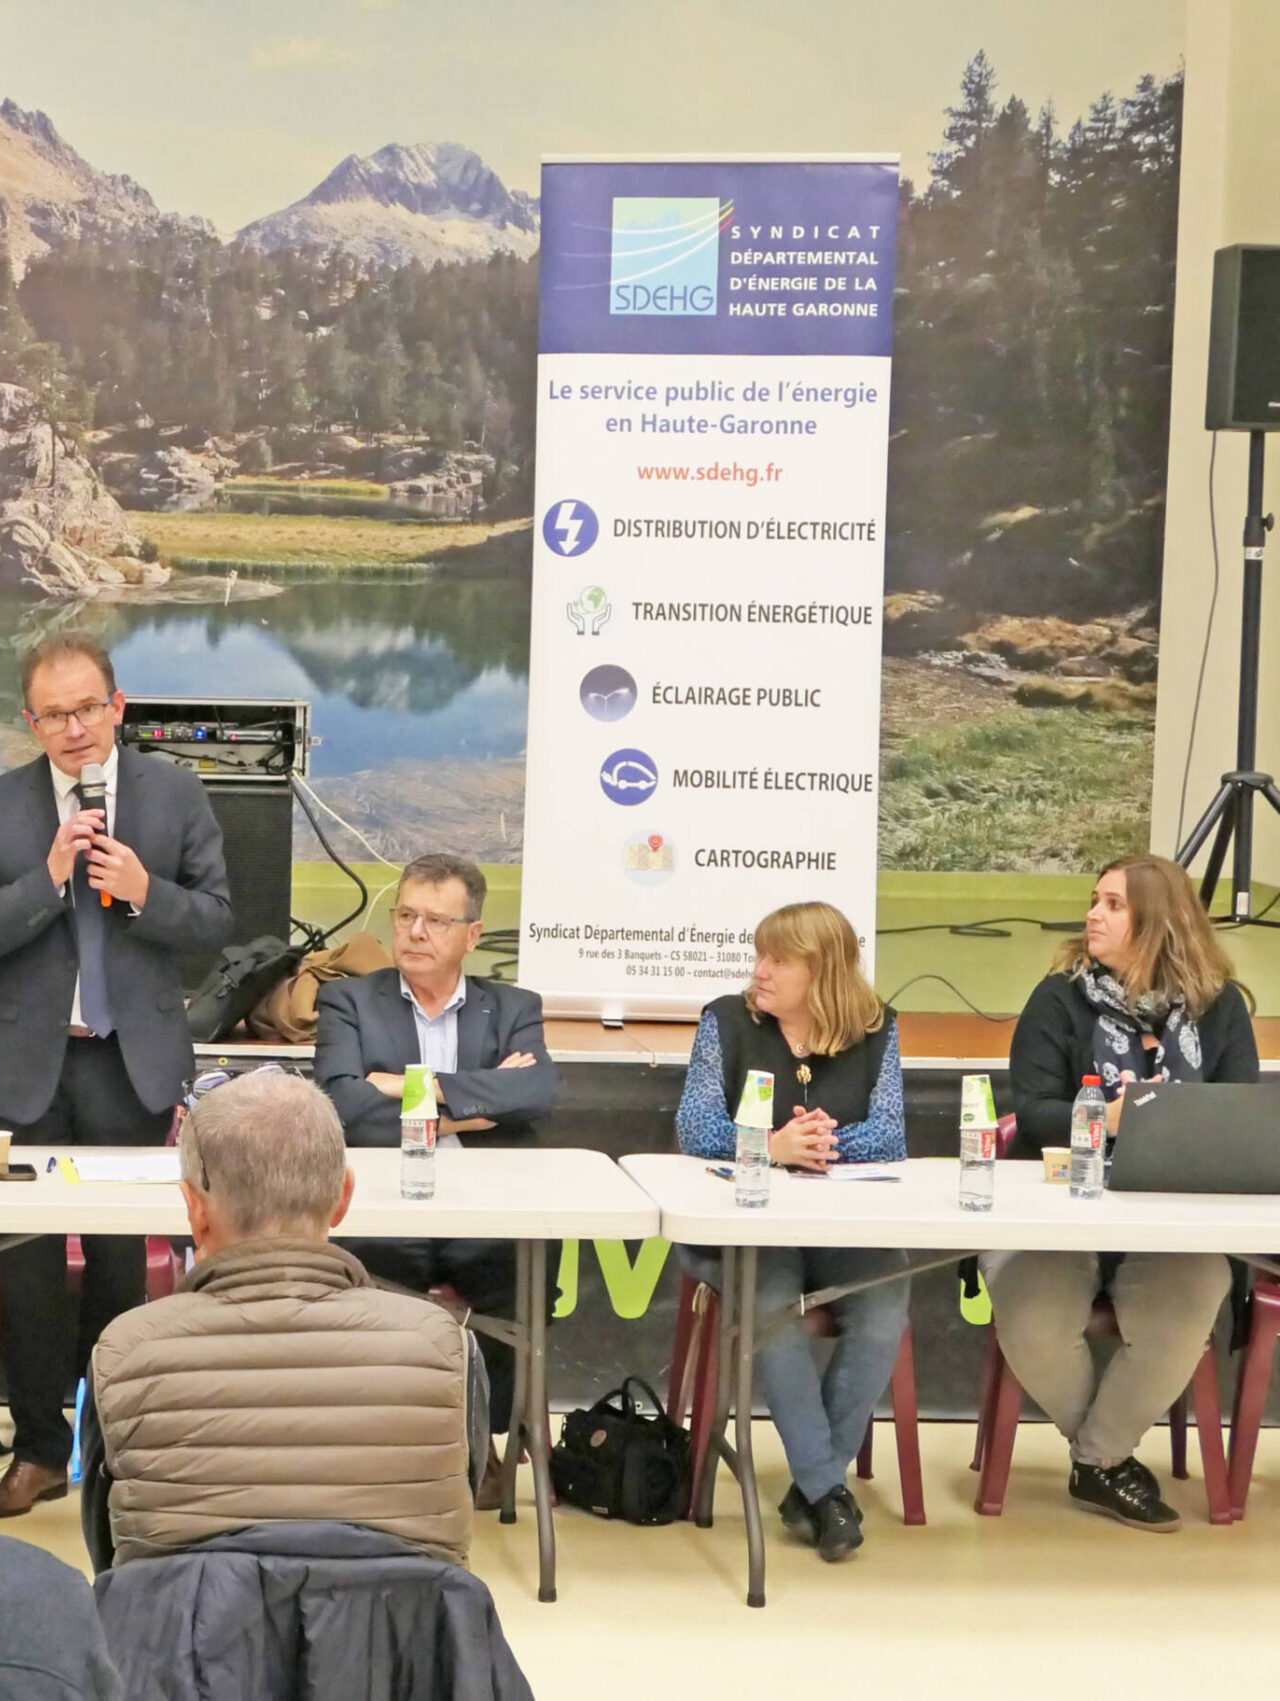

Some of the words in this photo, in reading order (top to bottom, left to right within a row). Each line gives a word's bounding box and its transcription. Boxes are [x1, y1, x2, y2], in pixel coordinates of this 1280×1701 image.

[732, 226, 880, 239] SYNDICAT
[731, 249, 878, 264] DÉPARTEMENTAL
[730, 274, 817, 290] D'ÉNERGIE
[824, 277, 846, 290] DE
[855, 278, 877, 290] LA
[615, 285, 714, 311] SDEHG
[729, 303, 786, 316] HAUTE
[792, 303, 878, 317] GARONNE
[550, 380, 572, 399] Le
[580, 380, 657, 400] service
[665, 380, 734, 406] public
[743, 381, 770, 402] de
[779, 381, 877, 408] l'énergie
[606, 418, 631, 432] en
[642, 414, 817, 434] Haute-Garonne
[638, 462, 783, 487] www.sdehg.fr
[614, 519, 741, 539] DISTRIBUTION
[747, 518, 875, 541] D'ÉLECTRICITÉ
[632, 602, 741, 622] TRANSITION
[748, 601, 872, 626] ÉNERGÉTIQUE
[653, 682, 751, 705] ÉCLAIRAGE
[757, 688, 821, 707] PUBLIC
[673, 768, 758, 789] MOBILITÉ
[764, 768, 872, 794] ÉLECTRIQUE
[695, 849, 836, 870] CARTOGRAPHIE
[529, 923, 580, 942] Syndicat
[585, 925, 674, 944] Départemental
[678, 924, 736, 947] d'Énergie
[739, 929, 754, 944] de
[585, 949, 599, 960] rue
[601, 948, 615, 960] des
[624, 949, 662, 961] Banquets
[670, 950, 681, 962] CS
[683, 950, 707, 962] 58021
